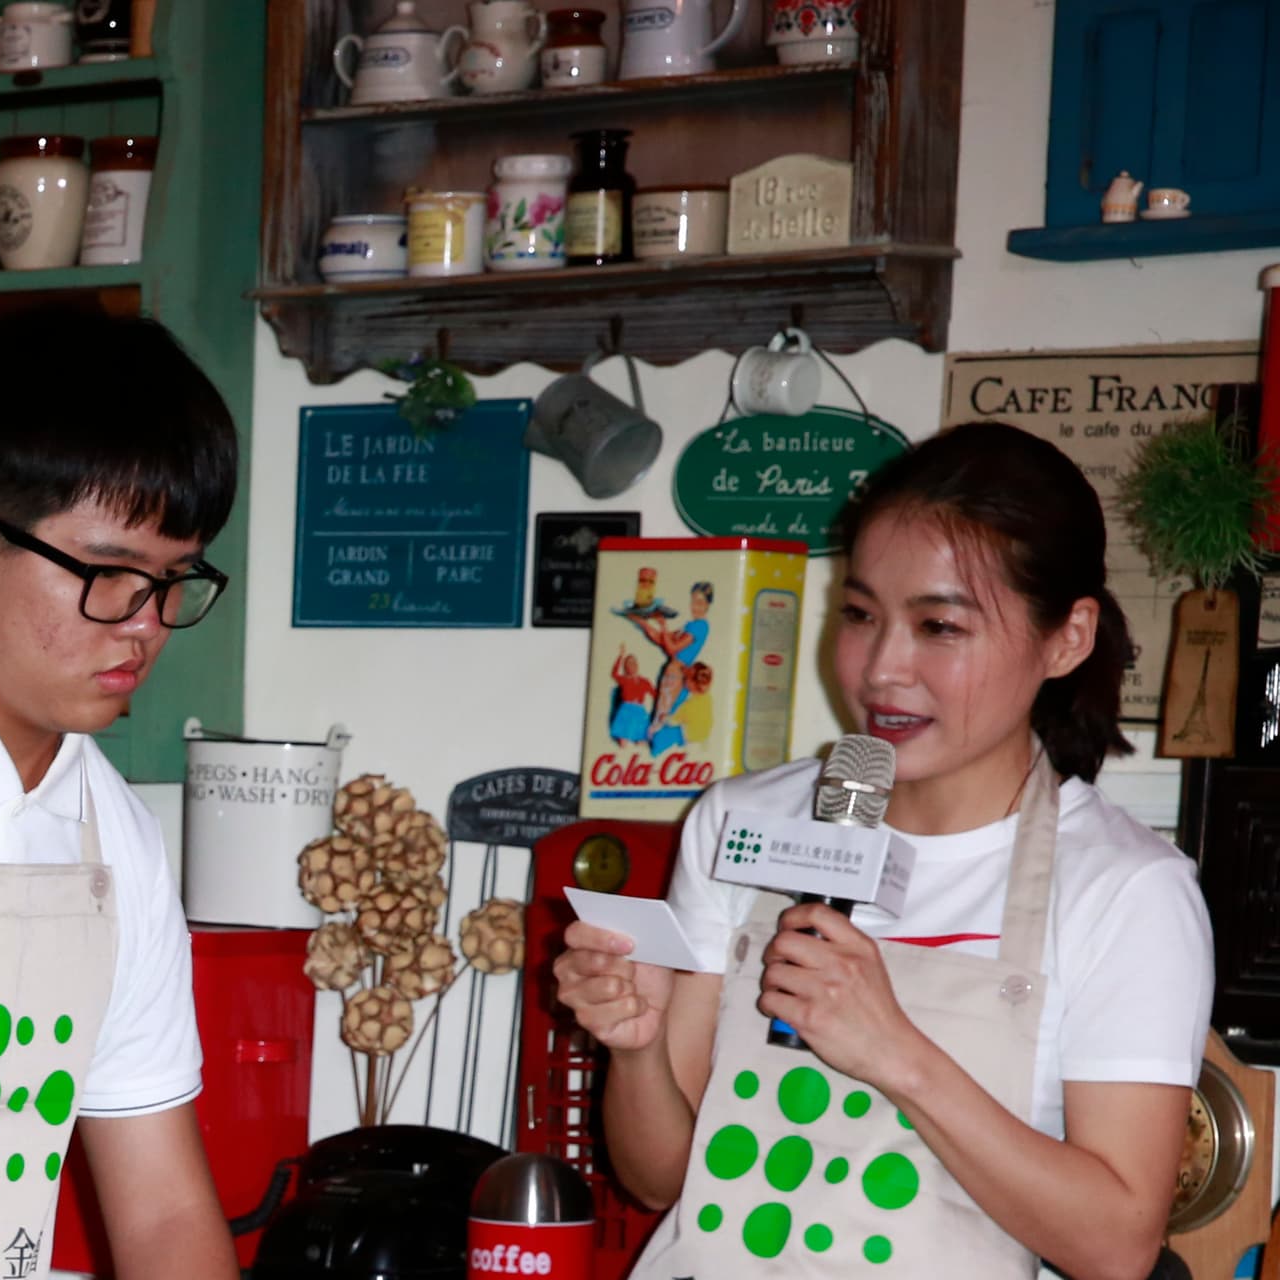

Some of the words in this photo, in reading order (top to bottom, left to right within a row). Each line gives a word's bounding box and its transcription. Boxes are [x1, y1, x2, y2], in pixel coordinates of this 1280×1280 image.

[1060, 423, 1074, 437] le
[1084, 421, 1120, 437] cafe
[1131, 420, 1152, 436] du
[324, 430, 354, 458] LE
[363, 434, 435, 461] JARDIN
[762, 431, 856, 453] banlieue
[327, 464, 352, 485] DE
[359, 464, 386, 485] LA
[712, 467, 740, 493] de
[755, 464, 835, 497] Paris
[327, 545, 388, 567] JARDIN
[423, 543, 496, 563] GALERIE
[327, 568, 391, 587] GRAND
[436, 565, 483, 584] PARC
[196, 763, 237, 782] PEGS
[253, 767, 319, 786] HANG
[591, 754, 653, 786] Cola
[660, 753, 713, 785] Cao
[219, 784, 276, 804] WASH
[532, 774, 556, 796] DE
[471, 1244, 552, 1276] coffee
